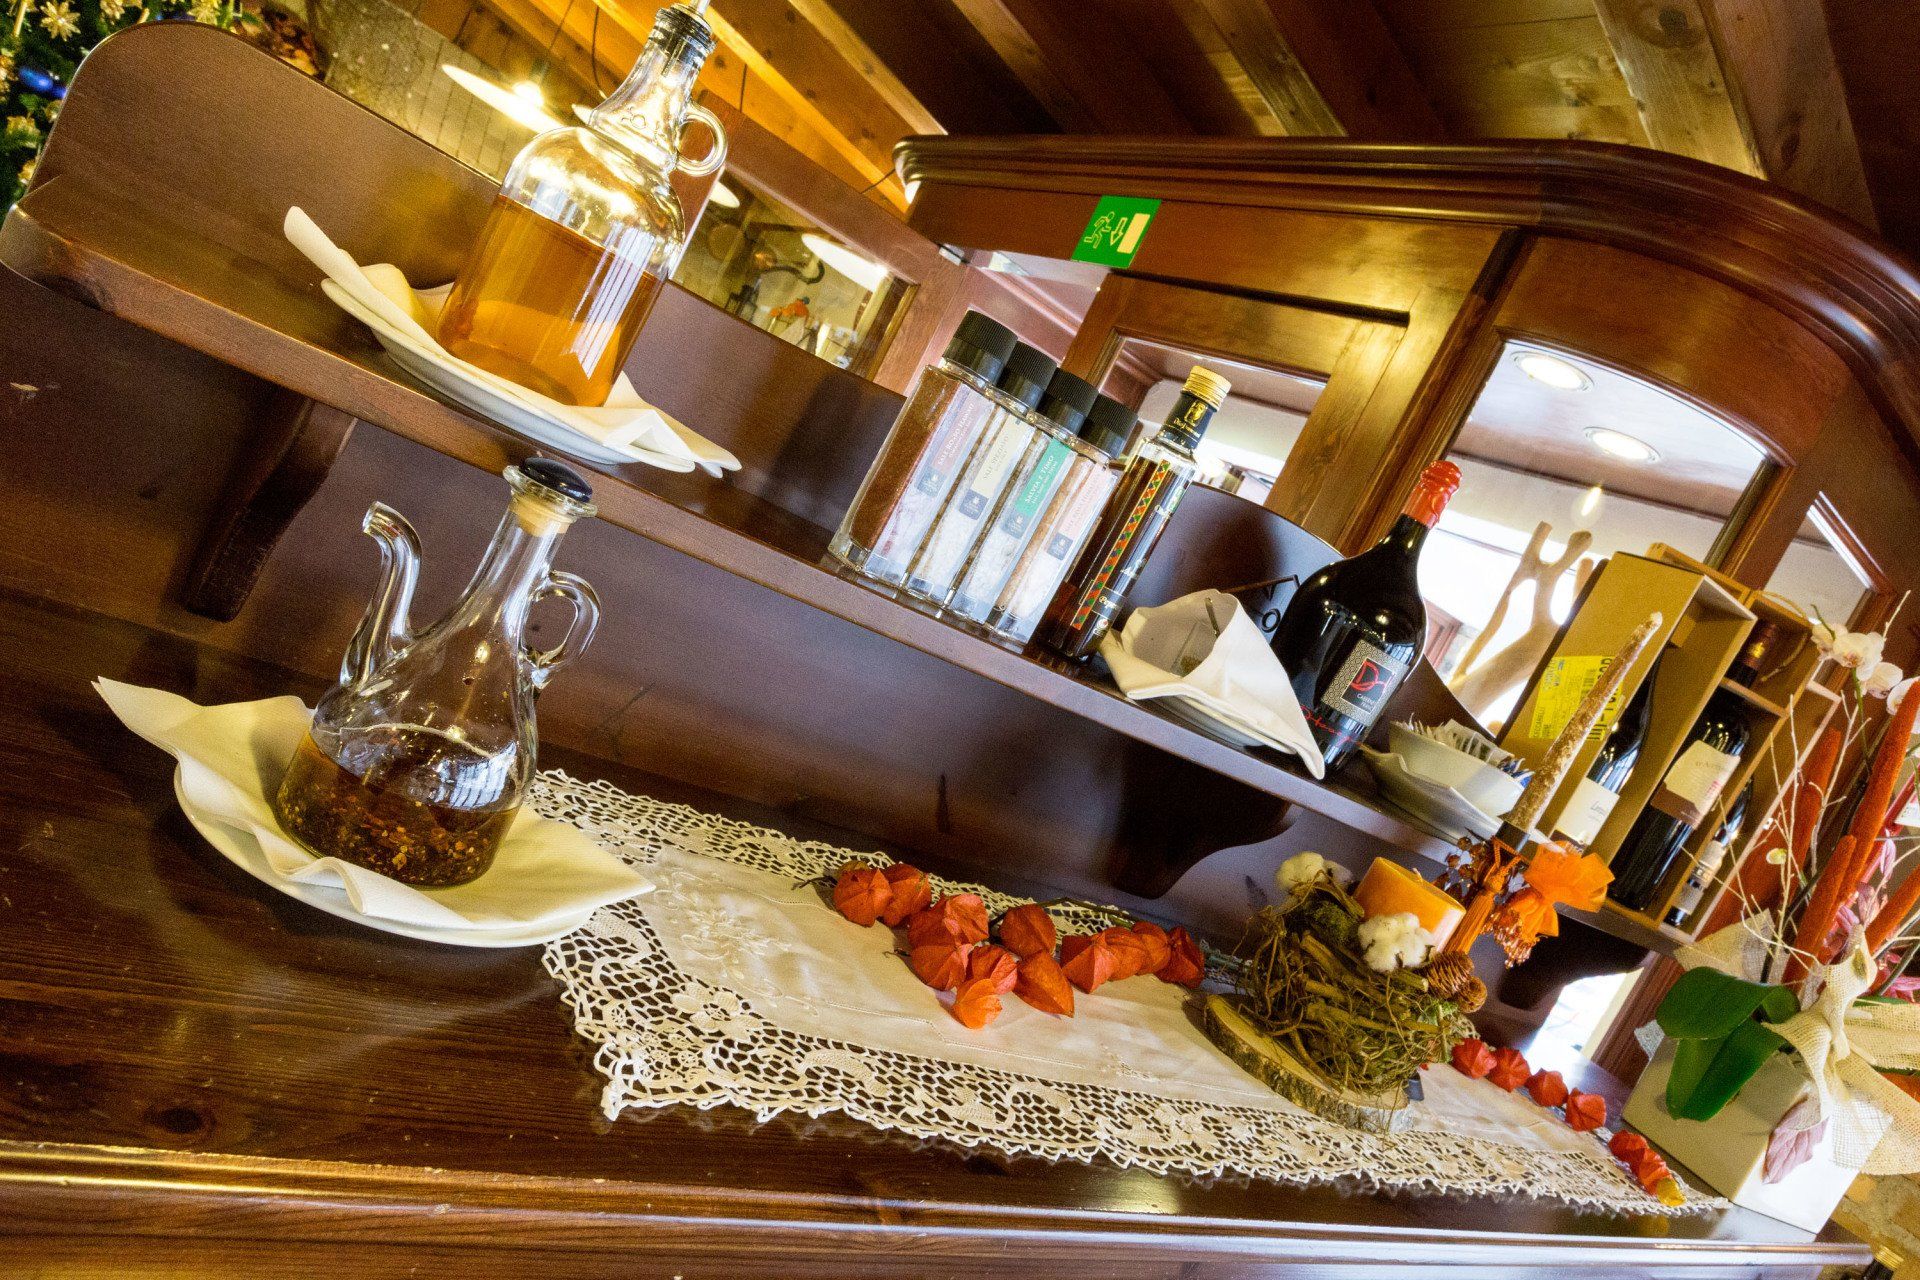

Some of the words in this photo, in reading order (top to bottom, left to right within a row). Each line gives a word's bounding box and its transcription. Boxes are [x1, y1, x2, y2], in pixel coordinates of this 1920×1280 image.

[936, 449, 949, 466] SALE
[1023, 479, 1041, 504] SALVIA
[1039, 452, 1055, 474] TIMO
